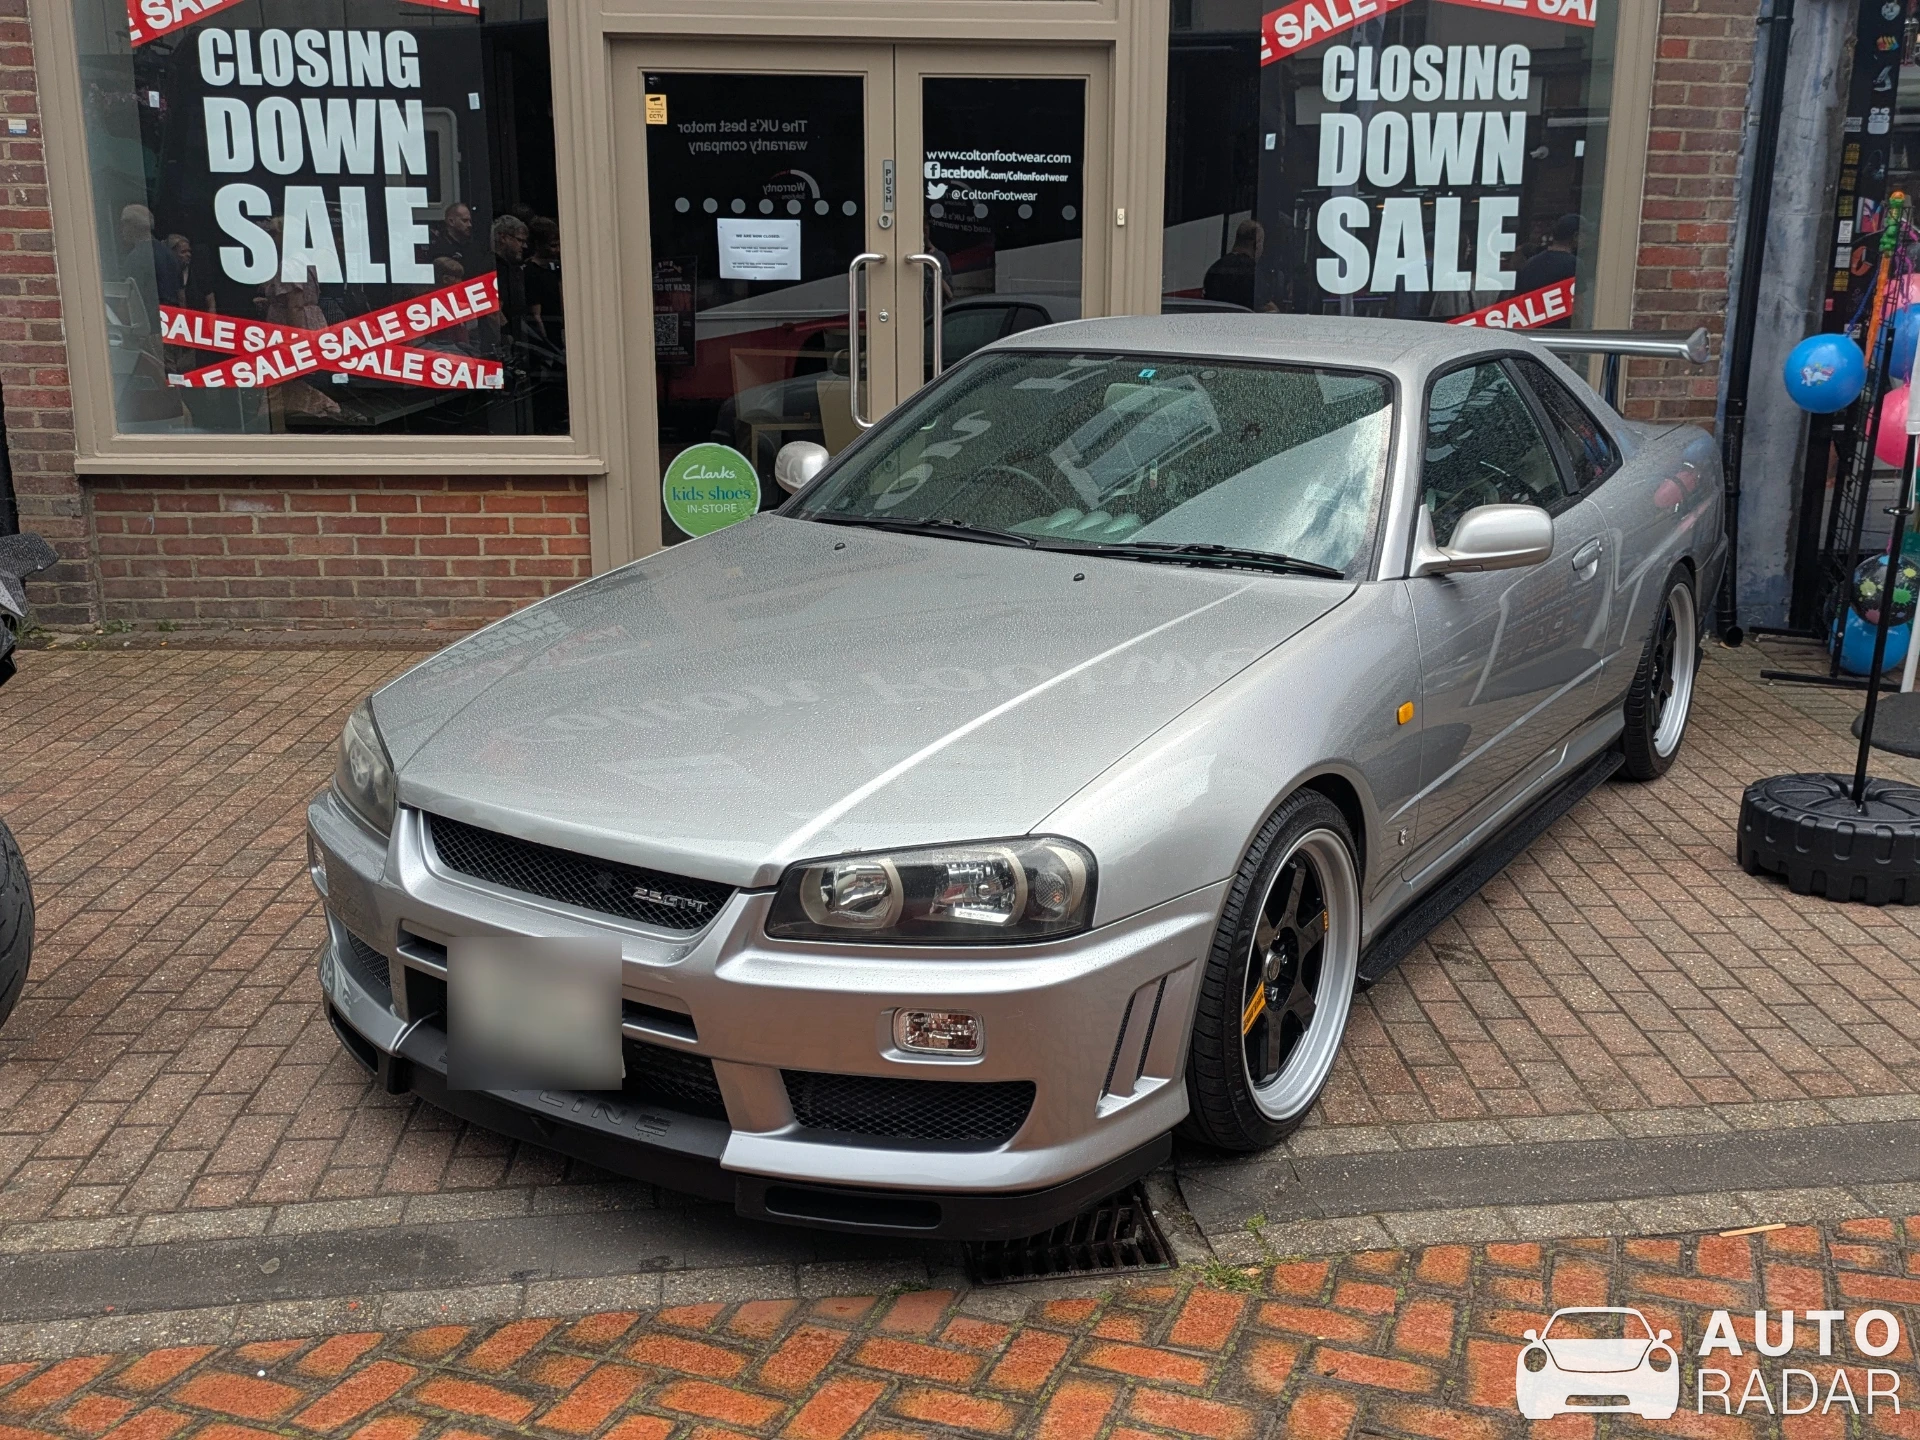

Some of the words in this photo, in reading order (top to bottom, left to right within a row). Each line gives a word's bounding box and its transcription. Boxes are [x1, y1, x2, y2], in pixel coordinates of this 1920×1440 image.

[198, 28, 420, 88] CLOSING
[1322, 44, 1531, 102] CLOSING
[203, 96, 427, 175] DOWN
[926, 150, 1071, 163] www.coltonfootwear.com
[1317, 111, 1527, 187] DOWN
[951, 190, 1038, 201] @ColtonFootwear
[214, 183, 435, 284] SALE
[1316, 196, 1520, 294] SALE
[231, 340, 318, 387] SALE
[318, 311, 406, 360] SALE
[406, 282, 493, 332] SALE
[1484, 288, 1567, 328] SALE
[672, 486, 704, 501] kids
[708, 486, 751, 501] shoes
[683, 464, 736, 480] Clarks
[687, 503, 738, 514] IN-STORE
[510, 1087, 672, 1137] LINE
